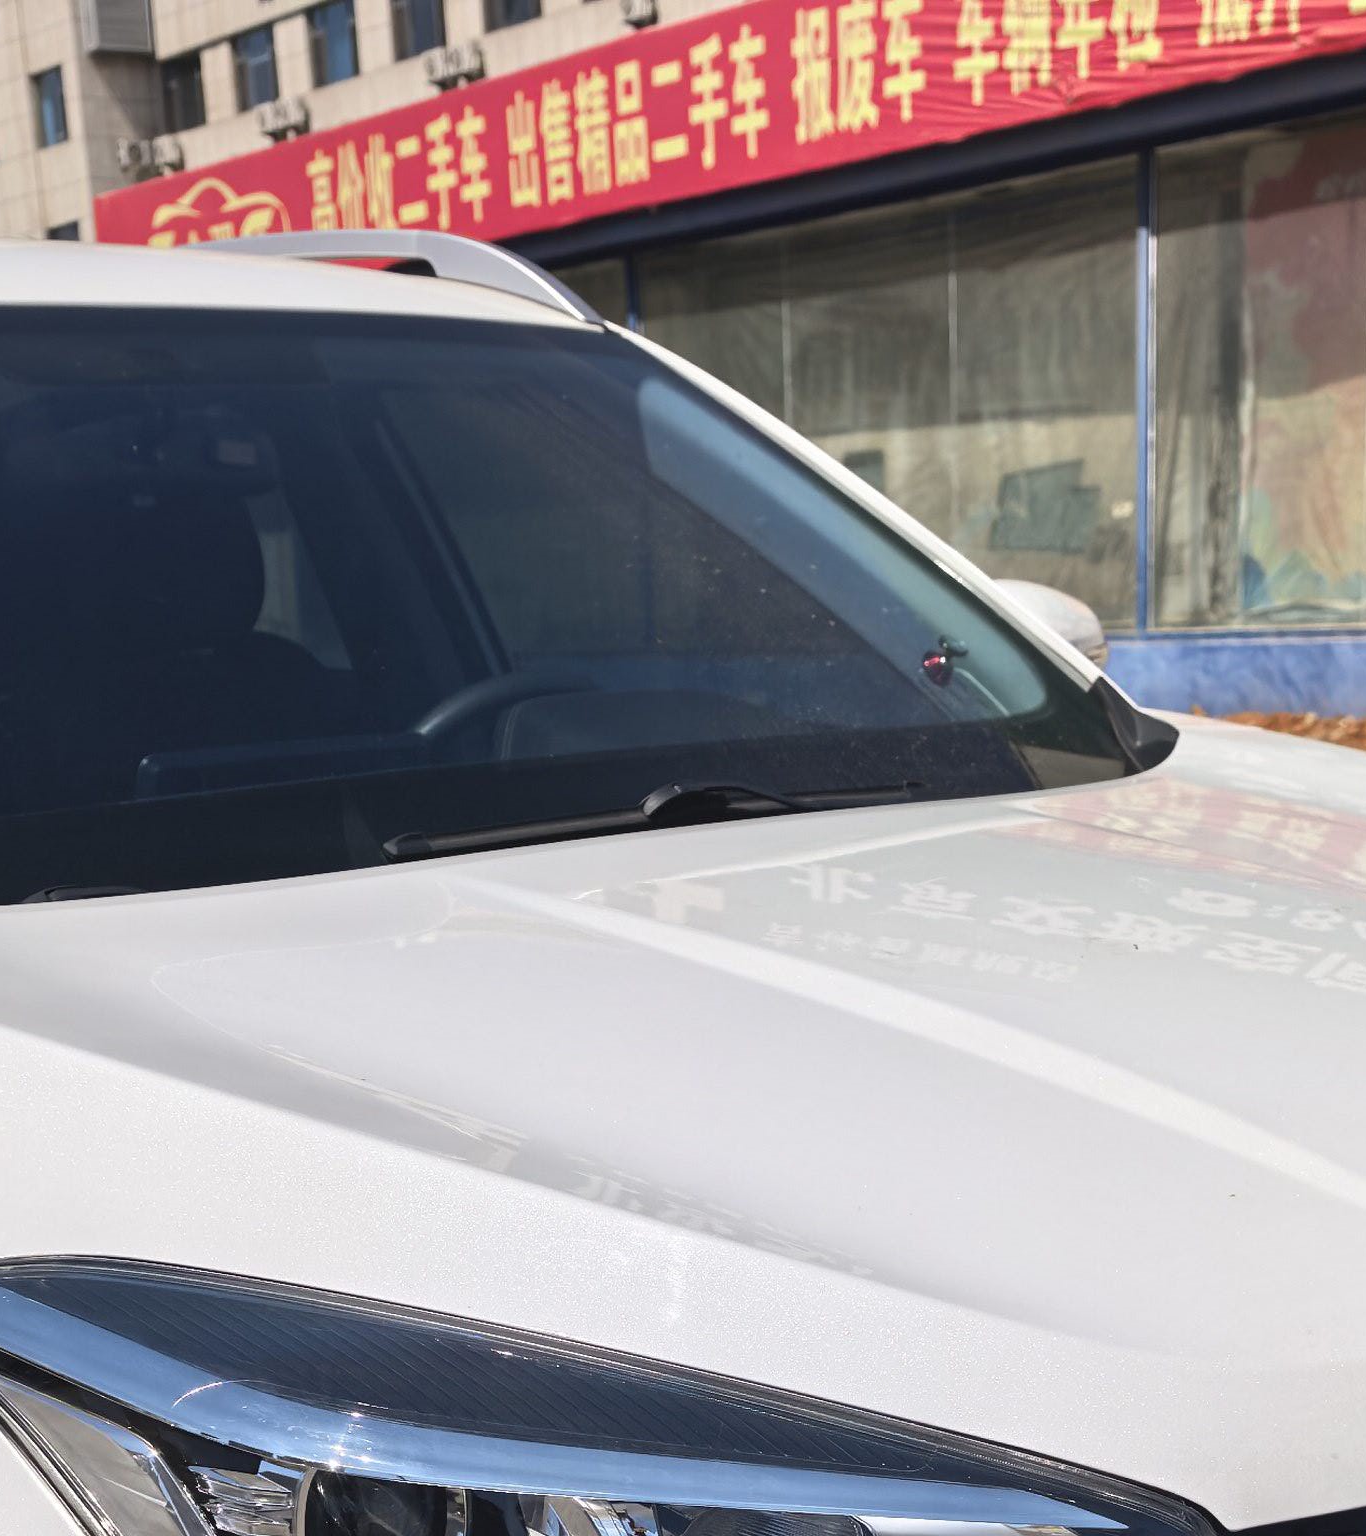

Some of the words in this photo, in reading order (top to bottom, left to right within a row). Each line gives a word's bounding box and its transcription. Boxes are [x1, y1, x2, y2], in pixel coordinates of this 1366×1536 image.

[506, 23, 771, 208] 出售精品二手车
[790, 0, 927, 144] 报废车
